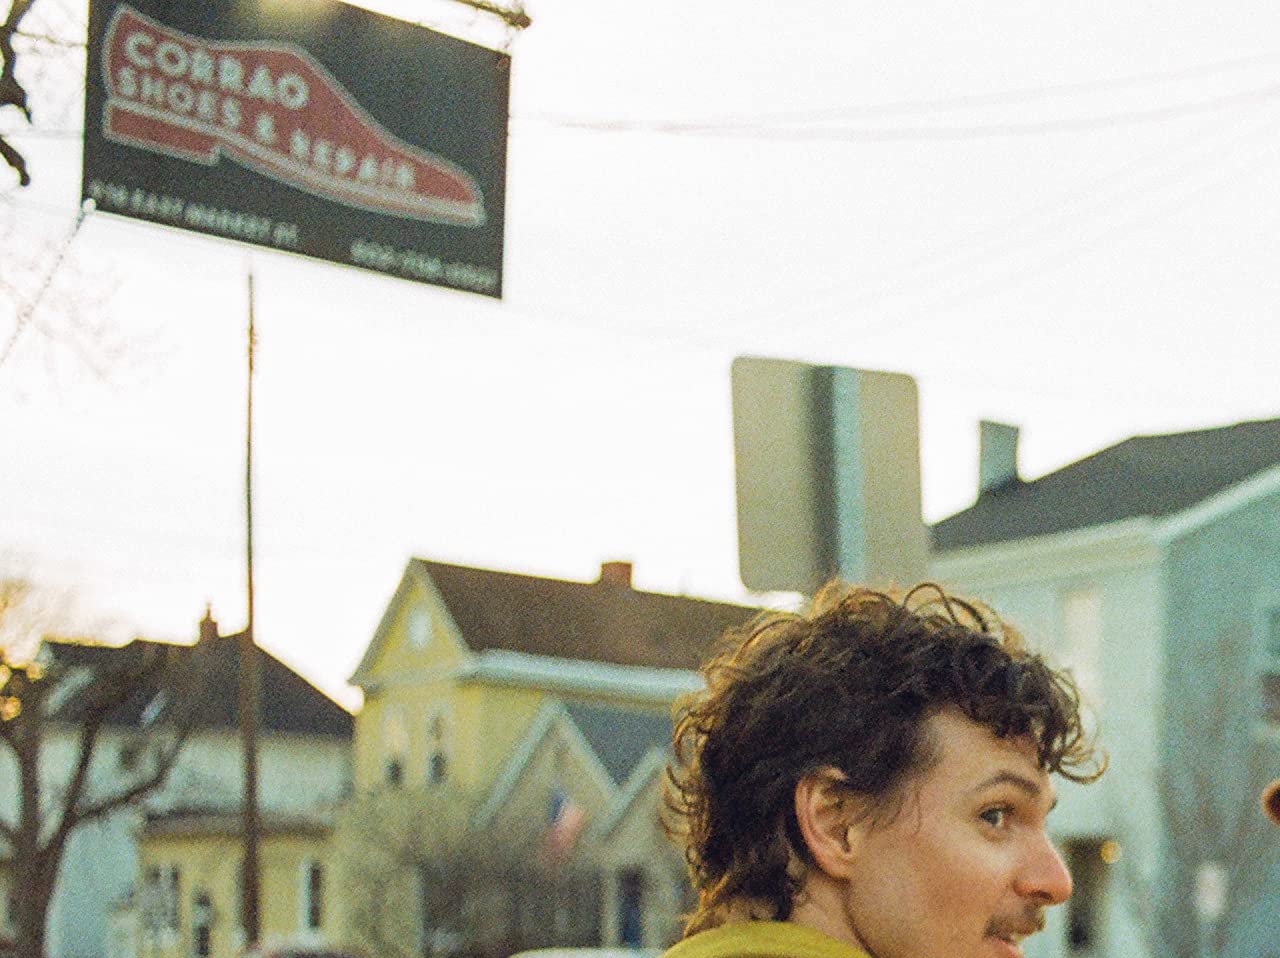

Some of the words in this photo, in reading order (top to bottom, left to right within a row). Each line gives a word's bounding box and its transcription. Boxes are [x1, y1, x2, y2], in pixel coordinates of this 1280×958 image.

[124, 31, 310, 110] CORRAO
[119, 66, 243, 130] SHOES
[254, 112, 277, 146] &
[288, 128, 416, 190] REPAIR
